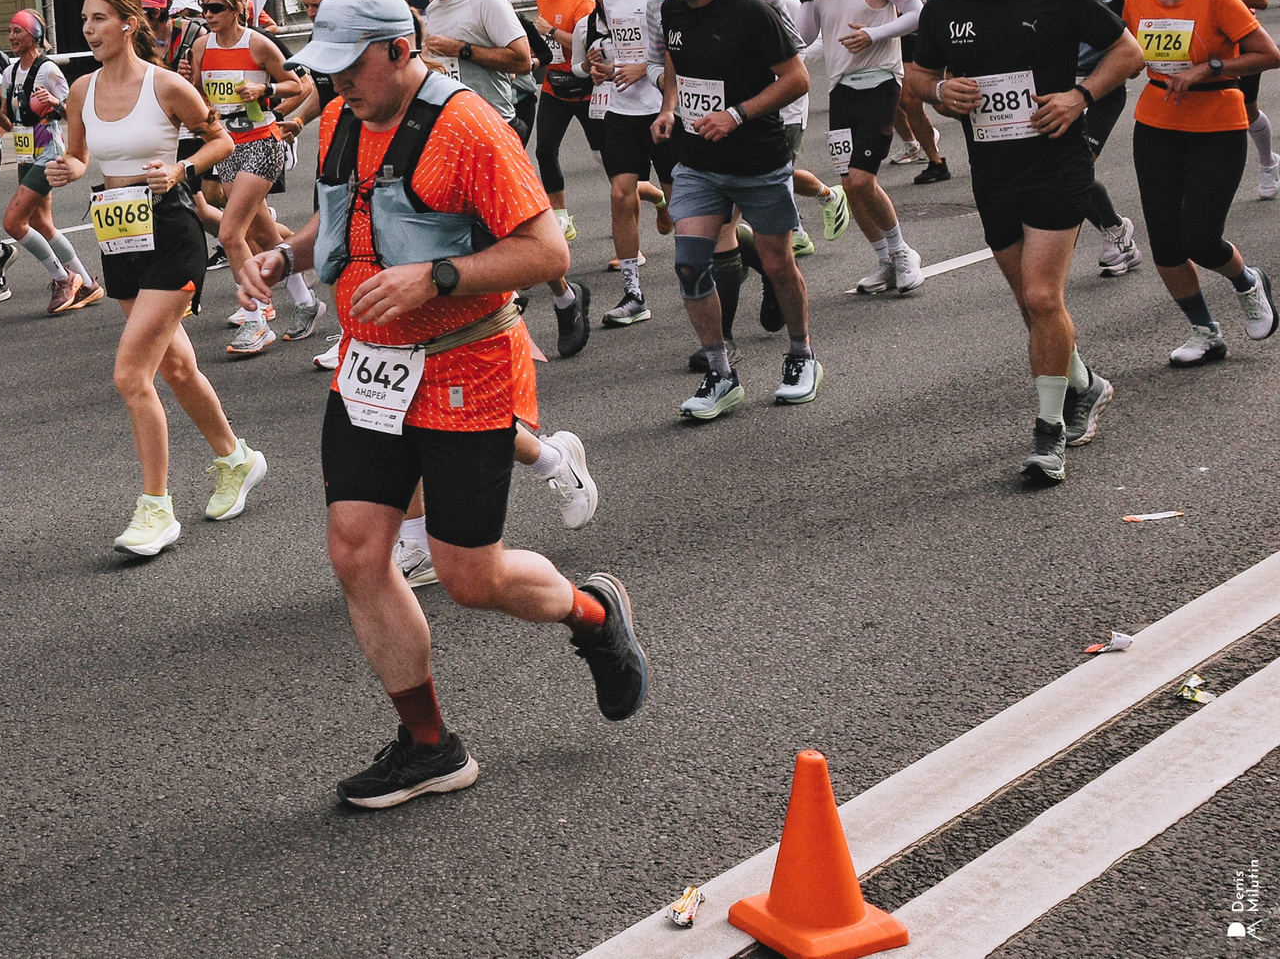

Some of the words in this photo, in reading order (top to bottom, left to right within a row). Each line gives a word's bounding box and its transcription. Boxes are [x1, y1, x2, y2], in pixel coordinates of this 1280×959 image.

[612, 27, 642, 42] 15225
[949, 21, 976, 39] SUR
[1144, 33, 1182, 51] 7126
[206, 81, 240, 96] 1708
[679, 90, 722, 112] 13752
[973, 88, 1033, 115] 2881
[94, 203, 150, 229] 16968
[355, 387, 387, 401] АНДРЕЙ
